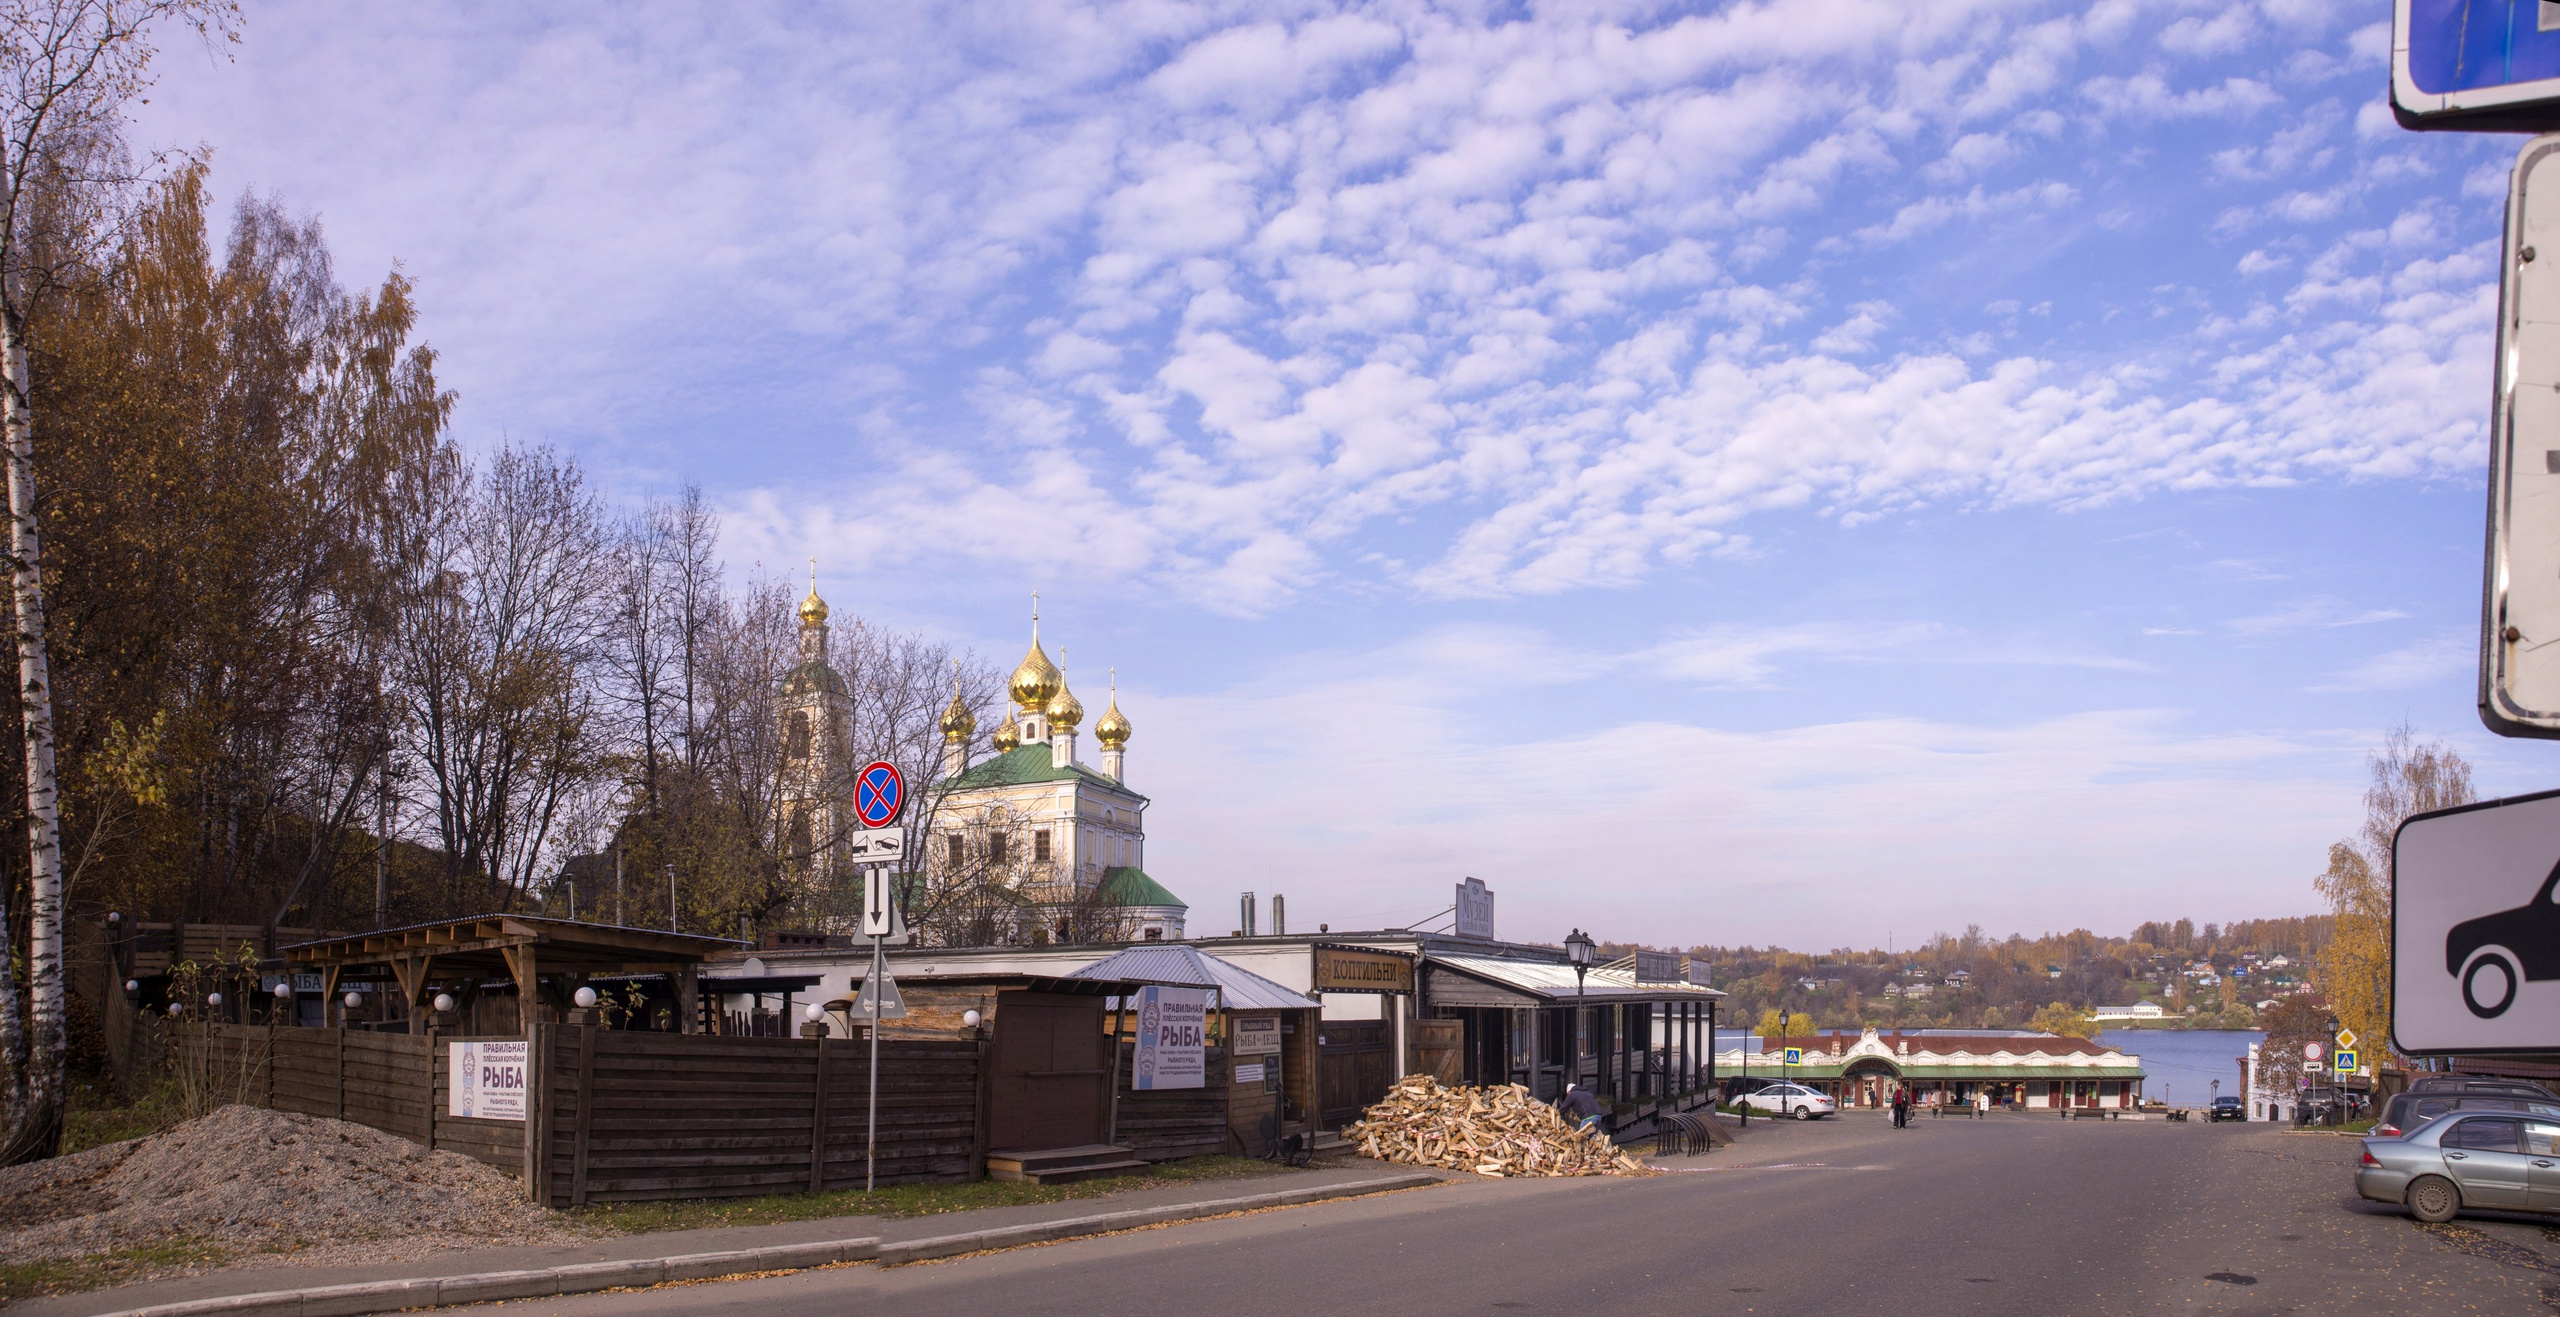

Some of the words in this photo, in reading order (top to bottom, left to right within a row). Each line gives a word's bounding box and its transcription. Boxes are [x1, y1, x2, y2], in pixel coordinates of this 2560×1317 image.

[1333, 959, 1397, 982] КОПТИЛЬНИ
[1163, 1002, 1204, 1013] ПРАВИЛЬНАЯ
[1162, 1014, 1182, 1022] ПЛЁССКАЯ
[1182, 1014, 1203, 1022] КОПЧЁНАЯ
[1160, 1025, 1202, 1047] РЫБА
[1235, 1033, 1256, 1047] РЫБА
[1262, 1033, 1280, 1047] ЛЕЩ
[483, 1043, 525, 1053] ПРАВИЛЬНАЯ
[483, 1054, 503, 1062] ПЛЁССКАЯ
[504, 1054, 525, 1063] КОПЧЁНАЯ
[483, 1066, 524, 1089] РЫБА
